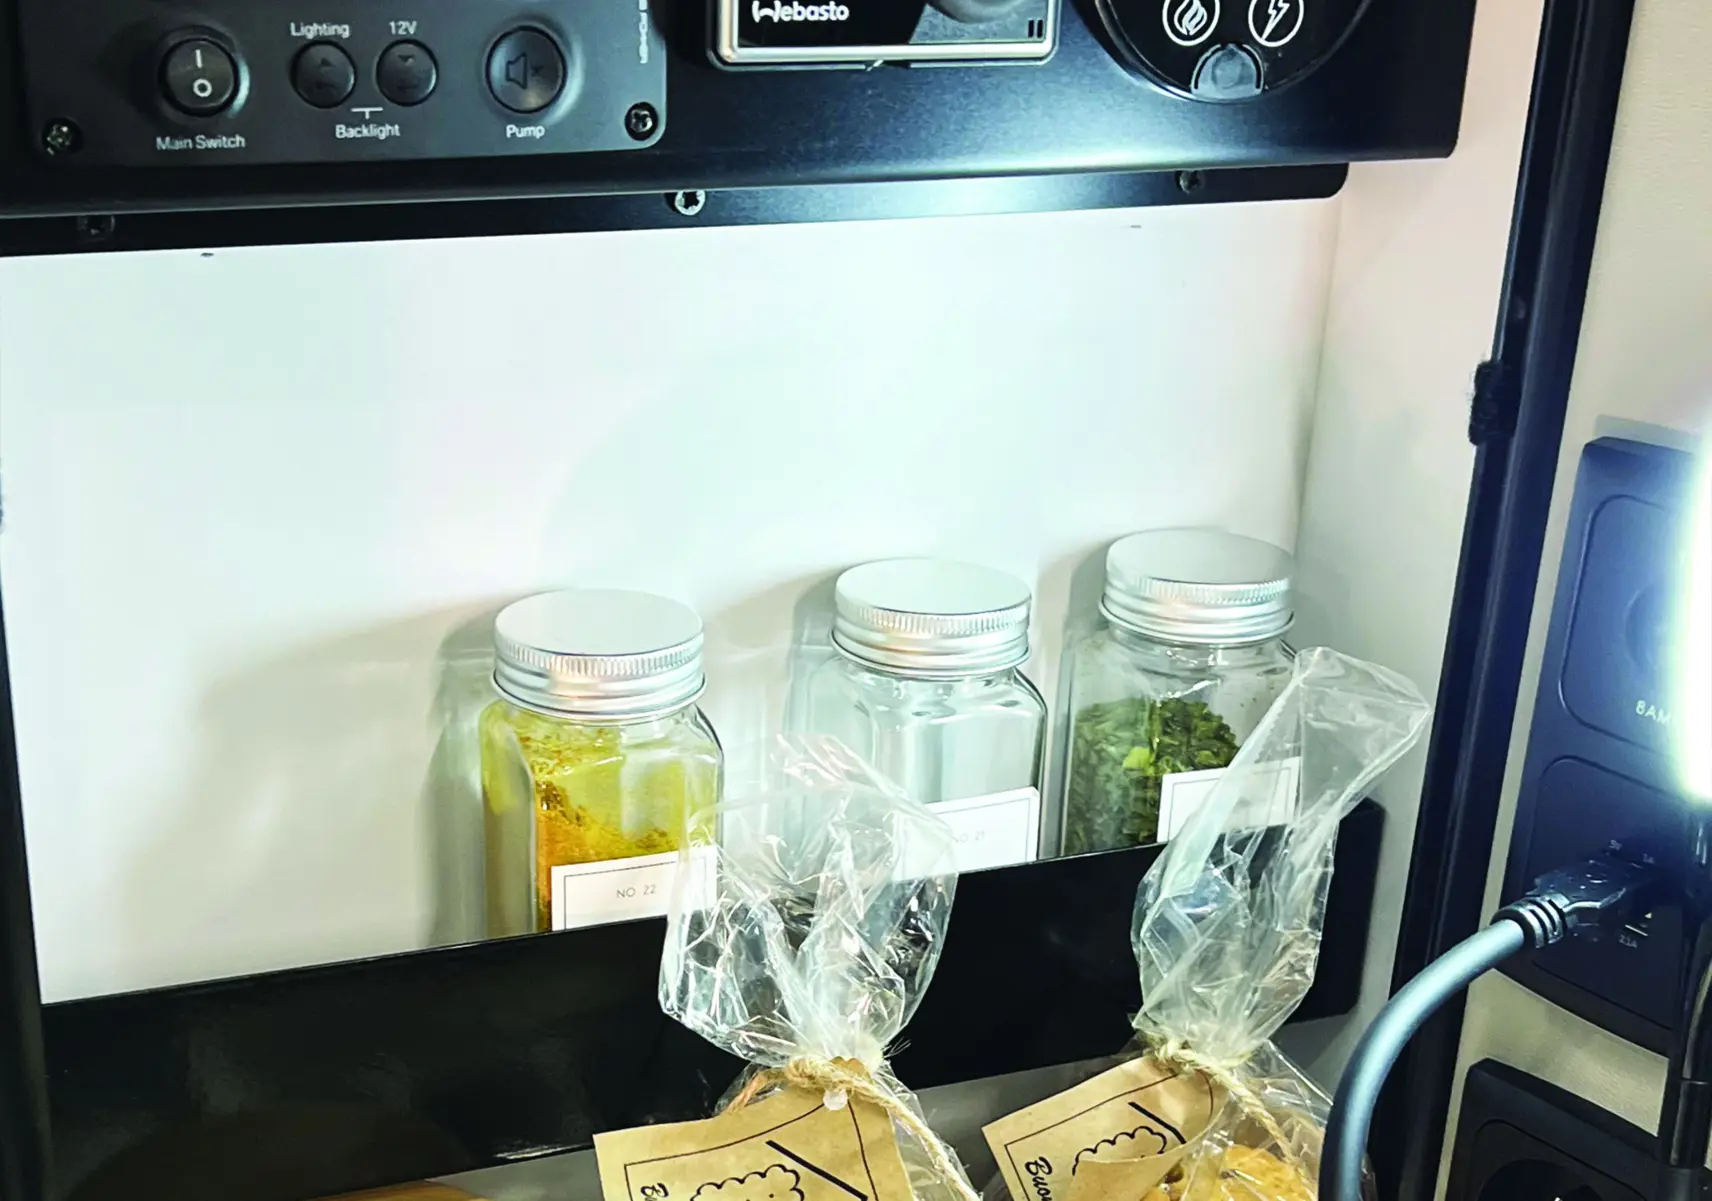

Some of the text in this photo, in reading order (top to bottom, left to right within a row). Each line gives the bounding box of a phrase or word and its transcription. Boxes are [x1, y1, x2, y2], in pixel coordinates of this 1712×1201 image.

[752, 0, 850, 23] Webasto
[290, 22, 350, 39] Lighting
[389, 21, 417, 35] 12V
[335, 124, 401, 139] Backlight
[506, 124, 546, 139] Pump
[156, 134, 246, 150] Main Switch
[616, 884, 657, 899] NO 22
